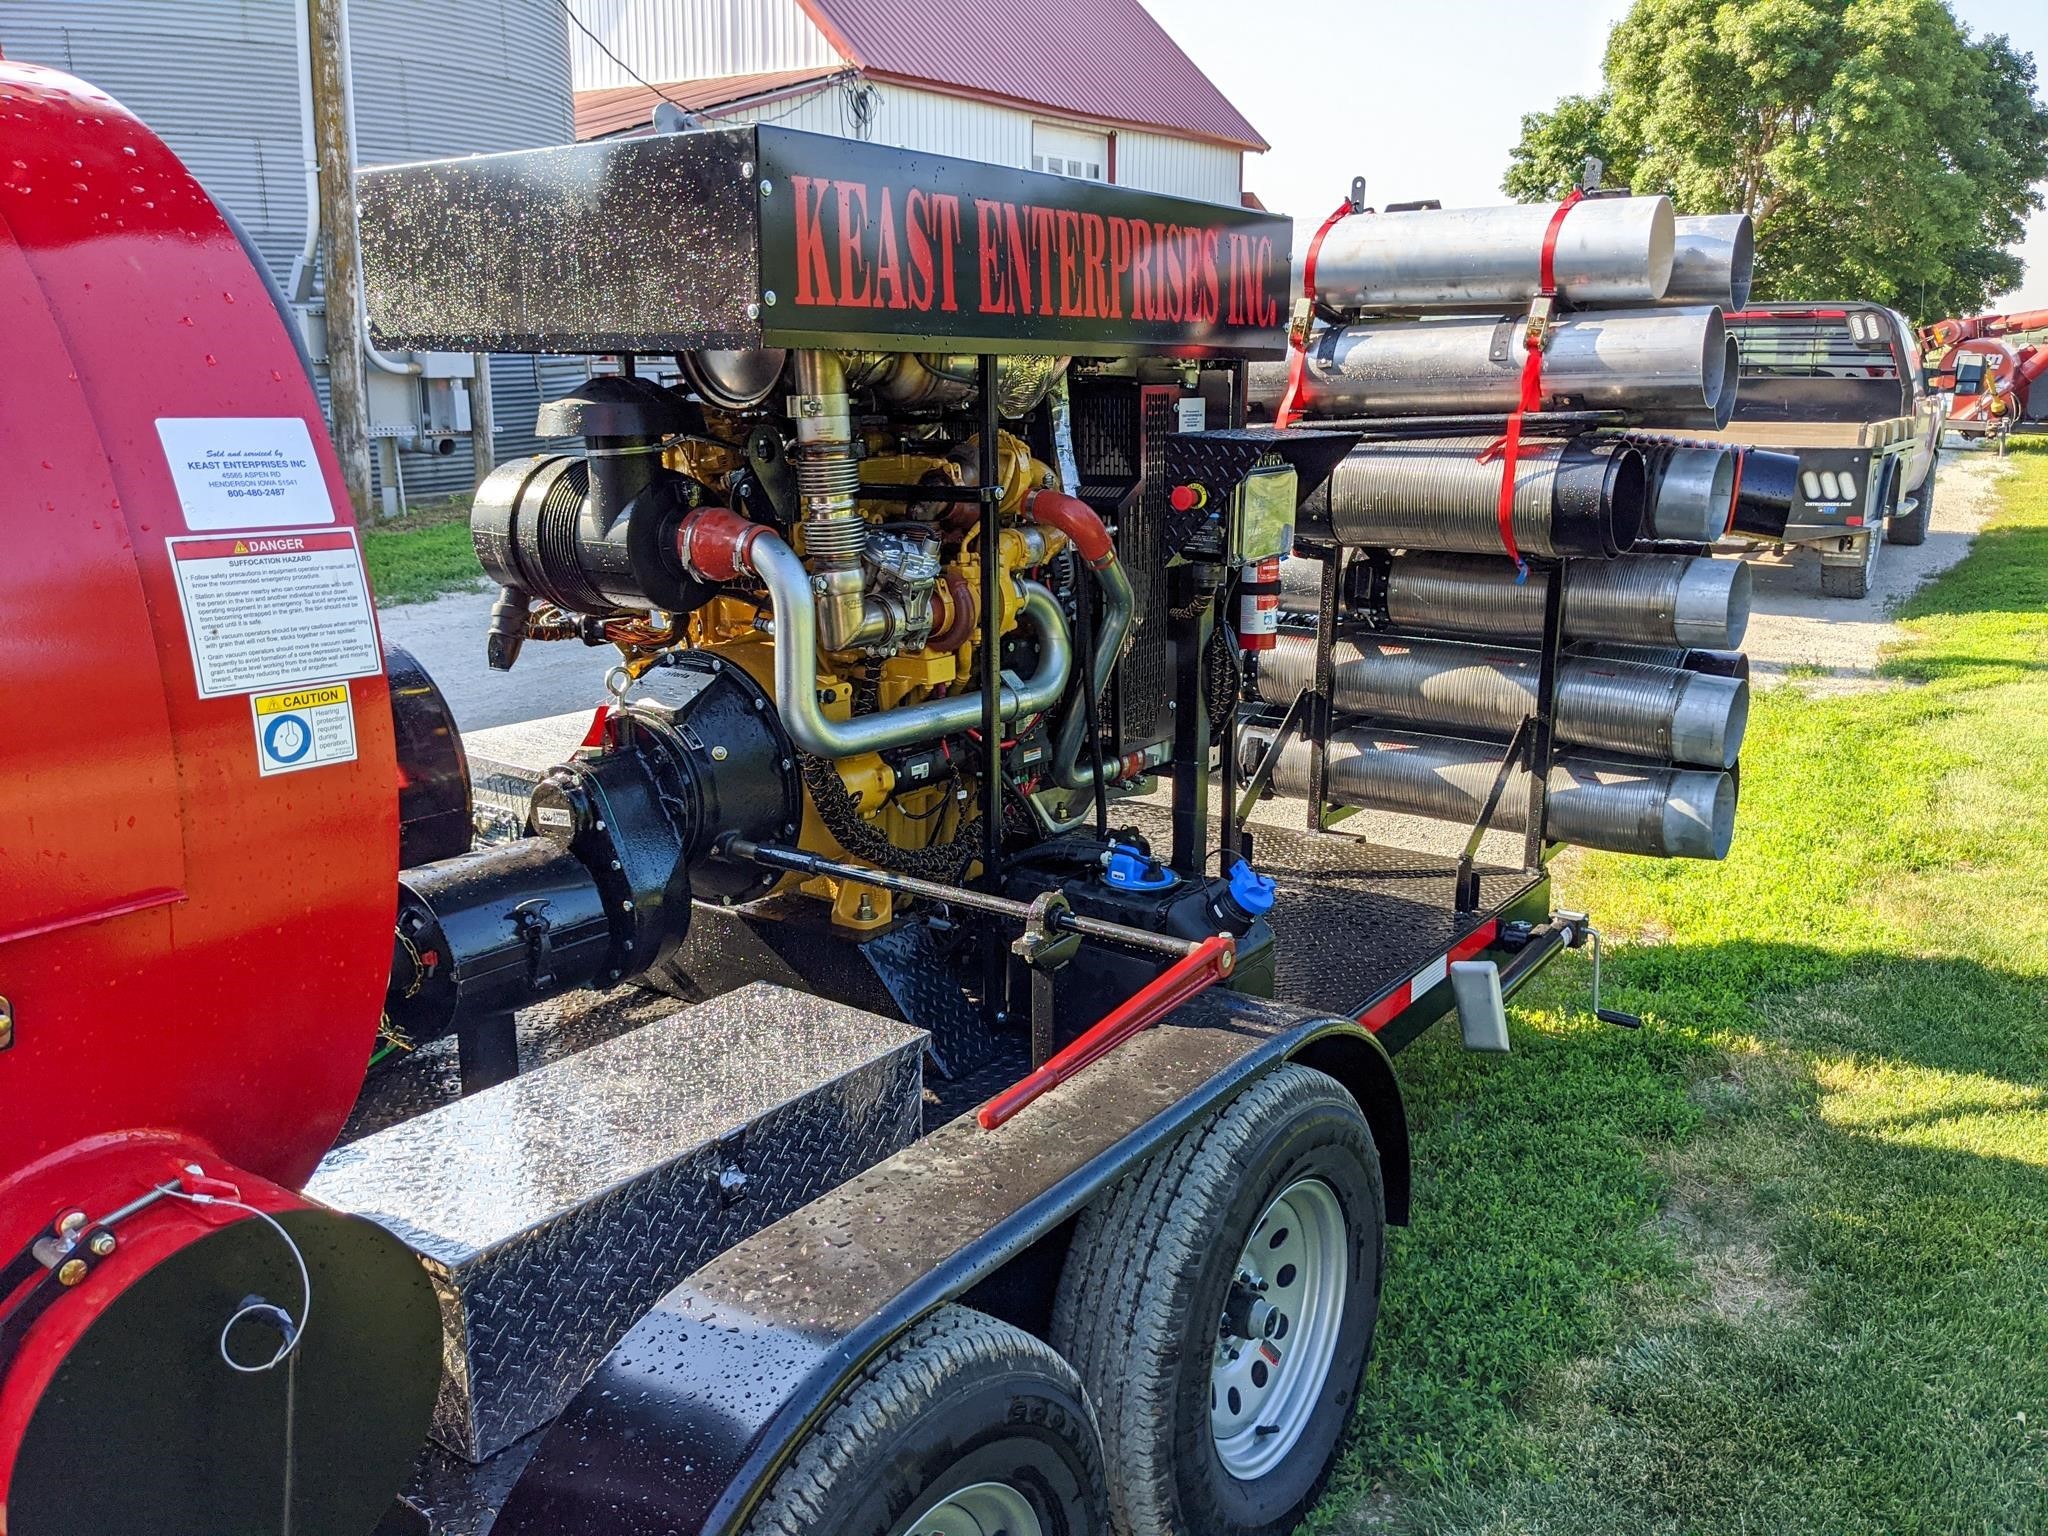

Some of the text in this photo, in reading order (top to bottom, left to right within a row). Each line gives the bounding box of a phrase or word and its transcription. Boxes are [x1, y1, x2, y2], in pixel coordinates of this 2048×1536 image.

[791, 175, 1277, 328] KEAST ENTERPRISES INC.
[206, 450, 225, 458] Sold
[274, 449, 283, 458] by
[187, 460, 306, 470] KEAST ENTERPRISES INC
[208, 480, 257, 488] HENDERSON
[227, 488, 285, 497] 800-480-2487
[249, 539, 304, 553] DANGER
[229, 555, 312, 567] SUFFOCATION HAZARD
[228, 570, 261, 579] precautions
[268, 566, 297, 575] equipment
[219, 577, 260, 586] recommended
[226, 604, 256, 612] equipment
[243, 610, 271, 618] entrapped
[201, 622, 224, 630] entered
[248, 648, 274, 656] operators
[208, 659, 237, 668] frequently
[283, 690, 338, 707] CAUTION
[315, 708, 340, 717] Hearing
[317, 715, 347, 726] protection
[317, 724, 342, 733] required
[319, 733, 338, 741] during
